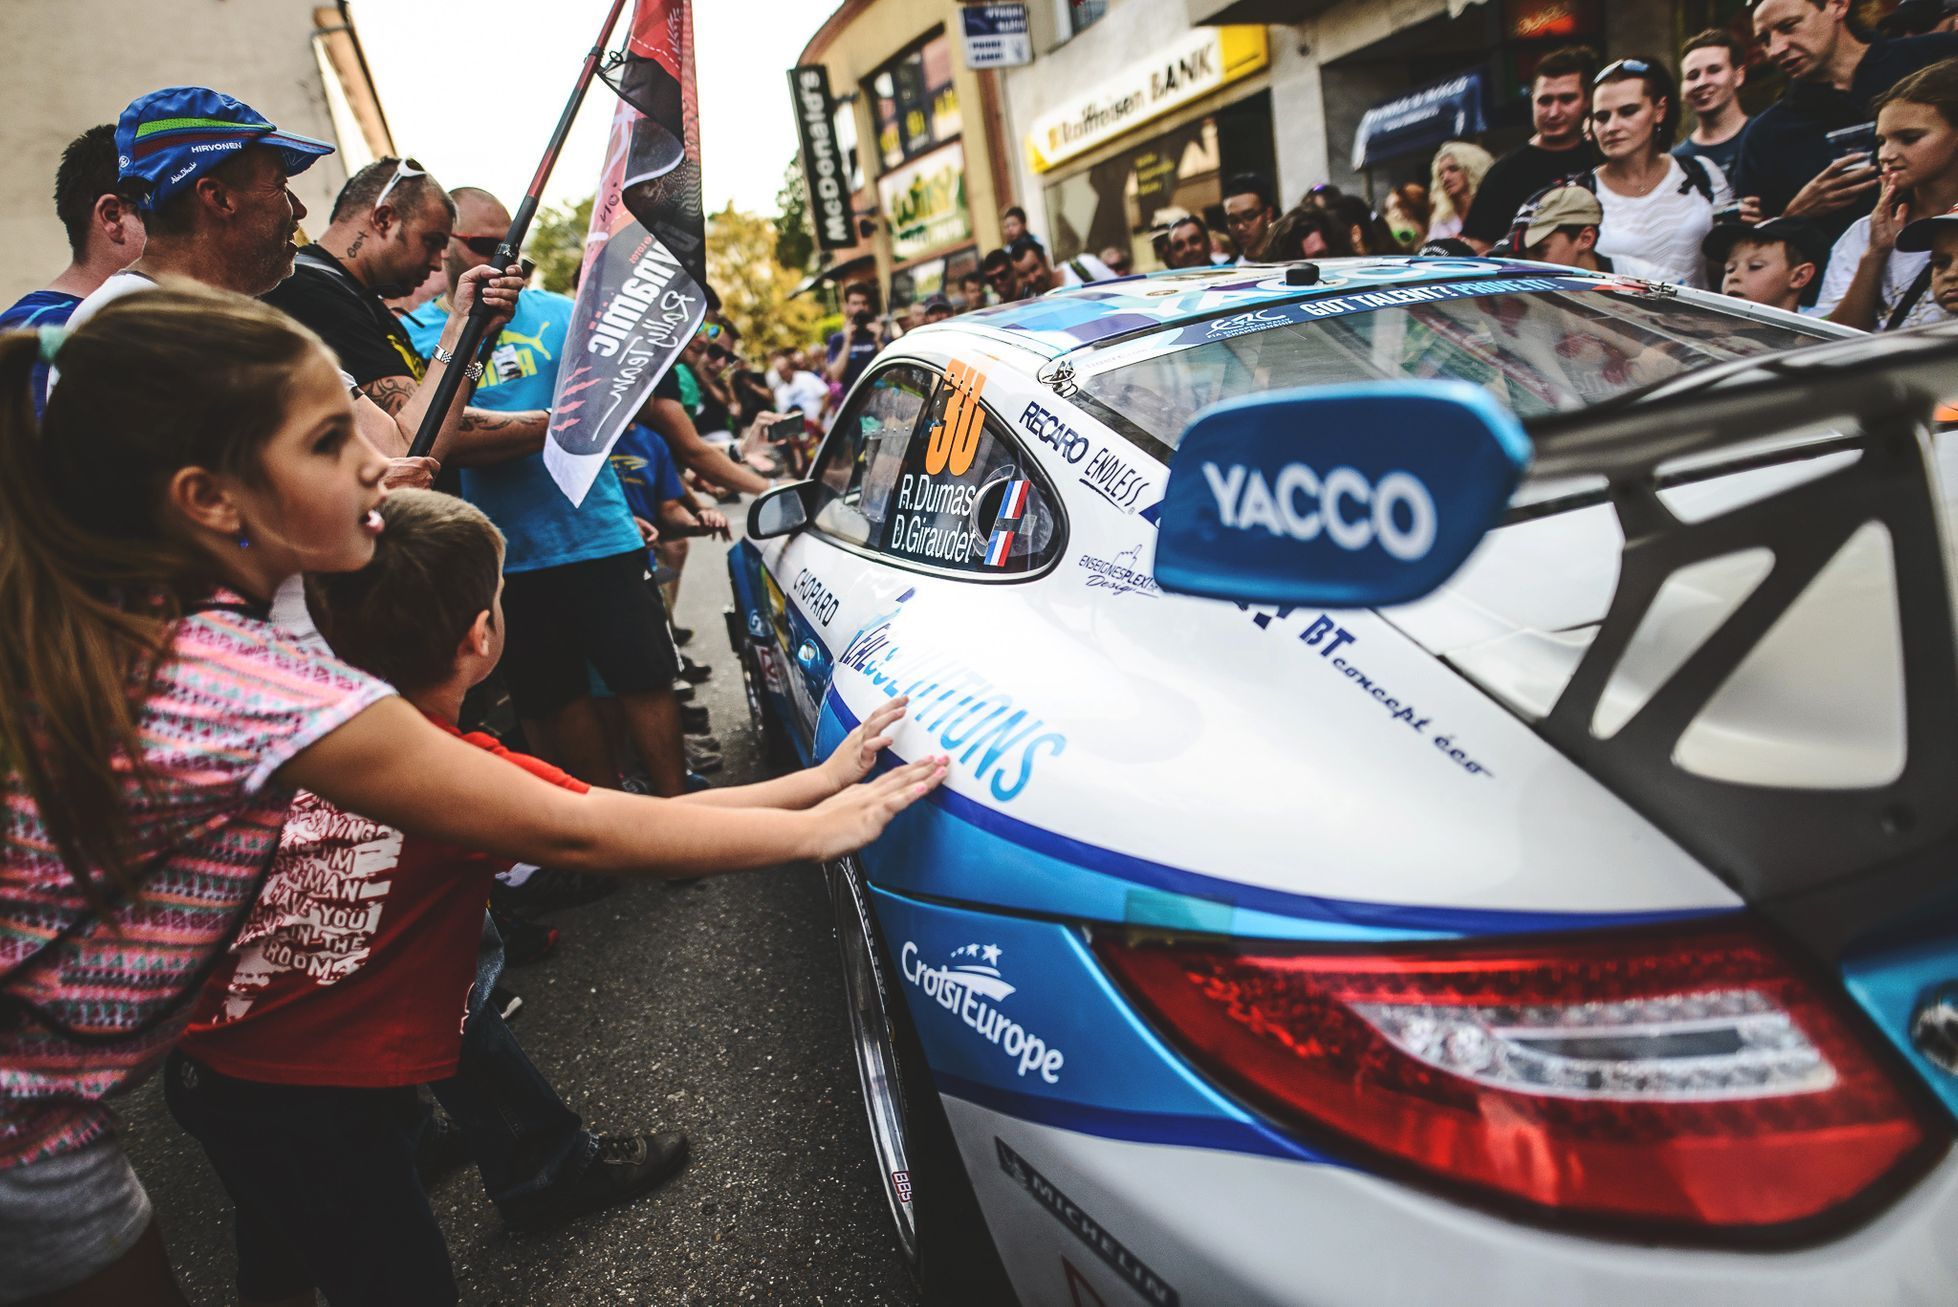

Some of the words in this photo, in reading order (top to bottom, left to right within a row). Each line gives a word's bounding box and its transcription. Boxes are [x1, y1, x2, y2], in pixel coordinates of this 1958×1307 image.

[1150, 43, 1213, 102] BANK
[191, 142, 242, 153] HIRVONEN
[800, 71, 848, 241] McDonald's
[1300, 298, 1357, 317] GOT
[1348, 285, 1458, 308] TALENT?
[1449, 280, 1526, 296] PROVE
[1019, 401, 1089, 464] RECARO
[1084, 448, 1150, 507] ENDLESS
[1202, 460, 1439, 562] YACCO
[793, 567, 840, 628] CHOPARD
[1086, 574, 1146, 596] Design
[319, 903, 368, 929] YOU
[320, 931, 367, 953] THE
[893, 1171, 912, 1201] BBS
[1032, 1176, 1168, 1304] MICHELIN
